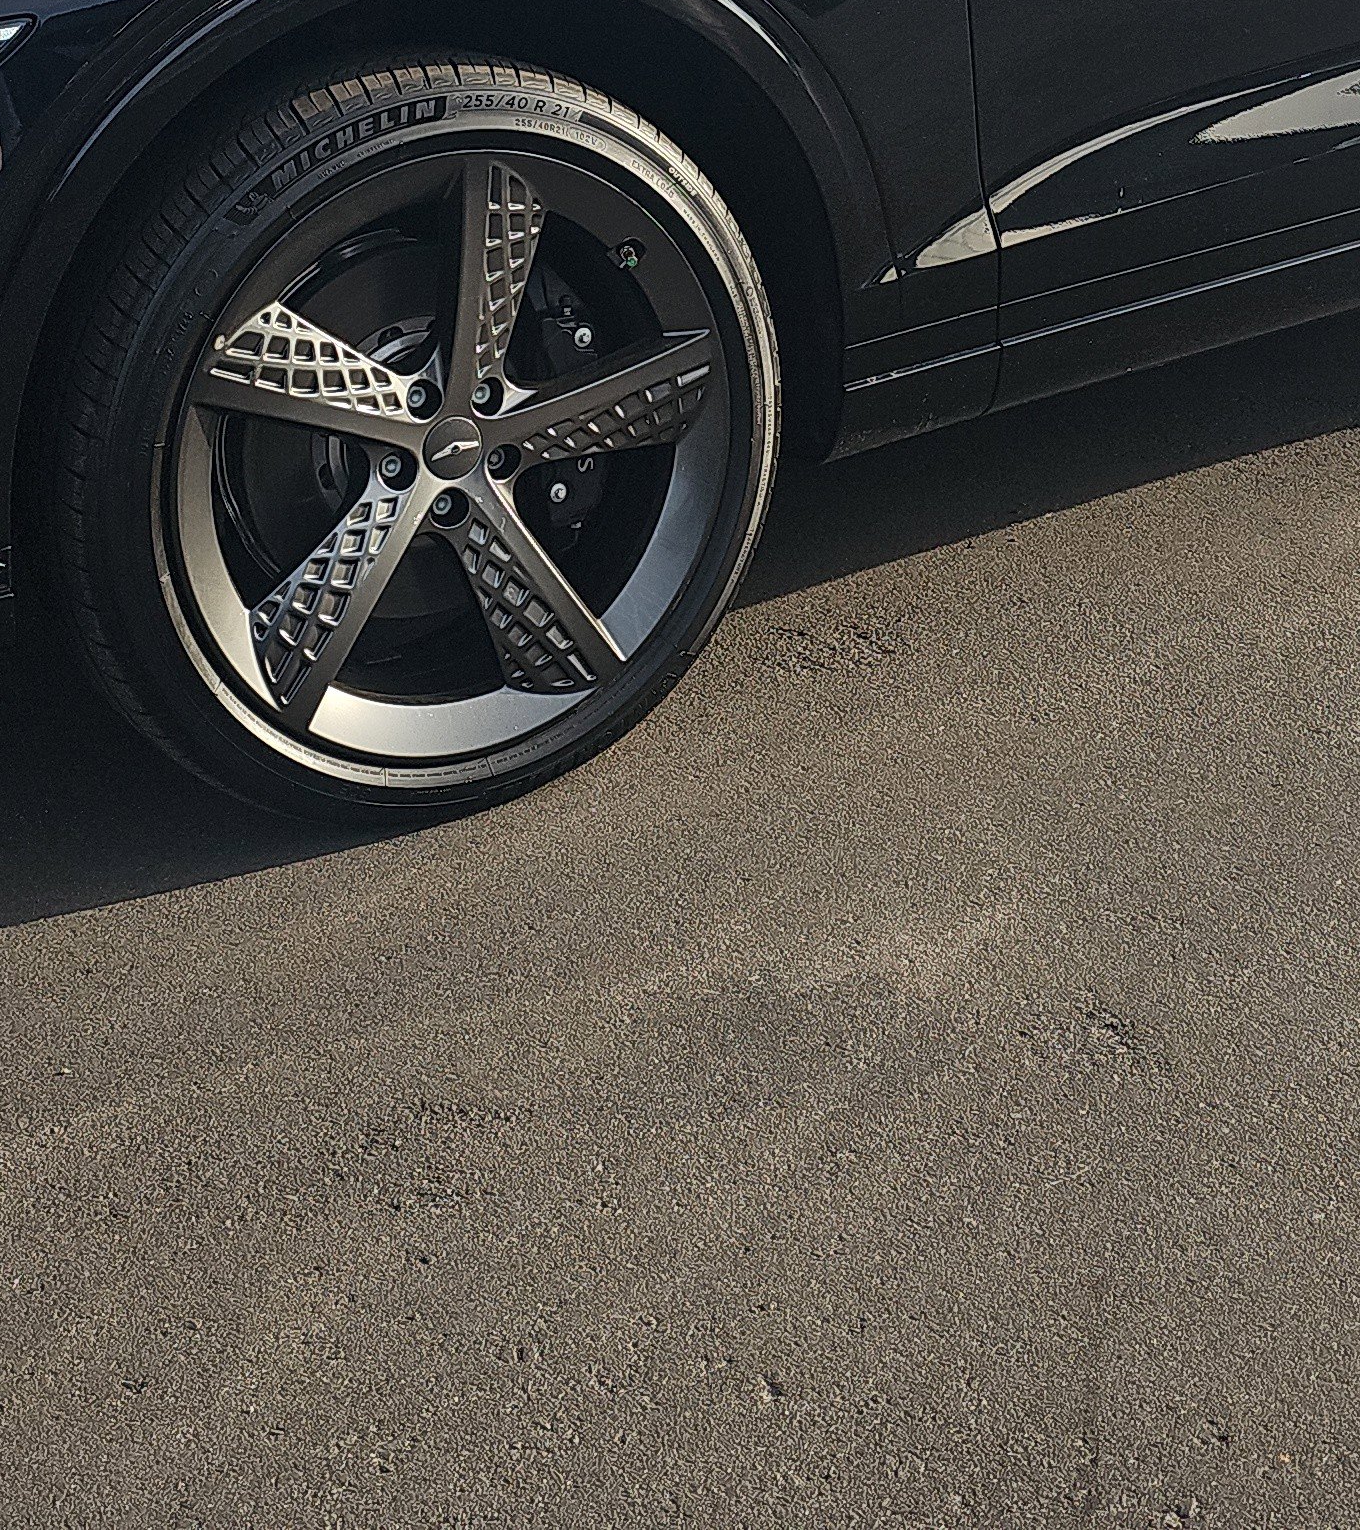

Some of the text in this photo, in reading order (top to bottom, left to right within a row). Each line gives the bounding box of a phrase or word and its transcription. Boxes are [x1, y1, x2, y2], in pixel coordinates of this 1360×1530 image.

[462, 94, 570, 119] 255/40 R 21
[271, 99, 436, 192] MICHELIN
[631, 159, 655, 182] EXTRA
